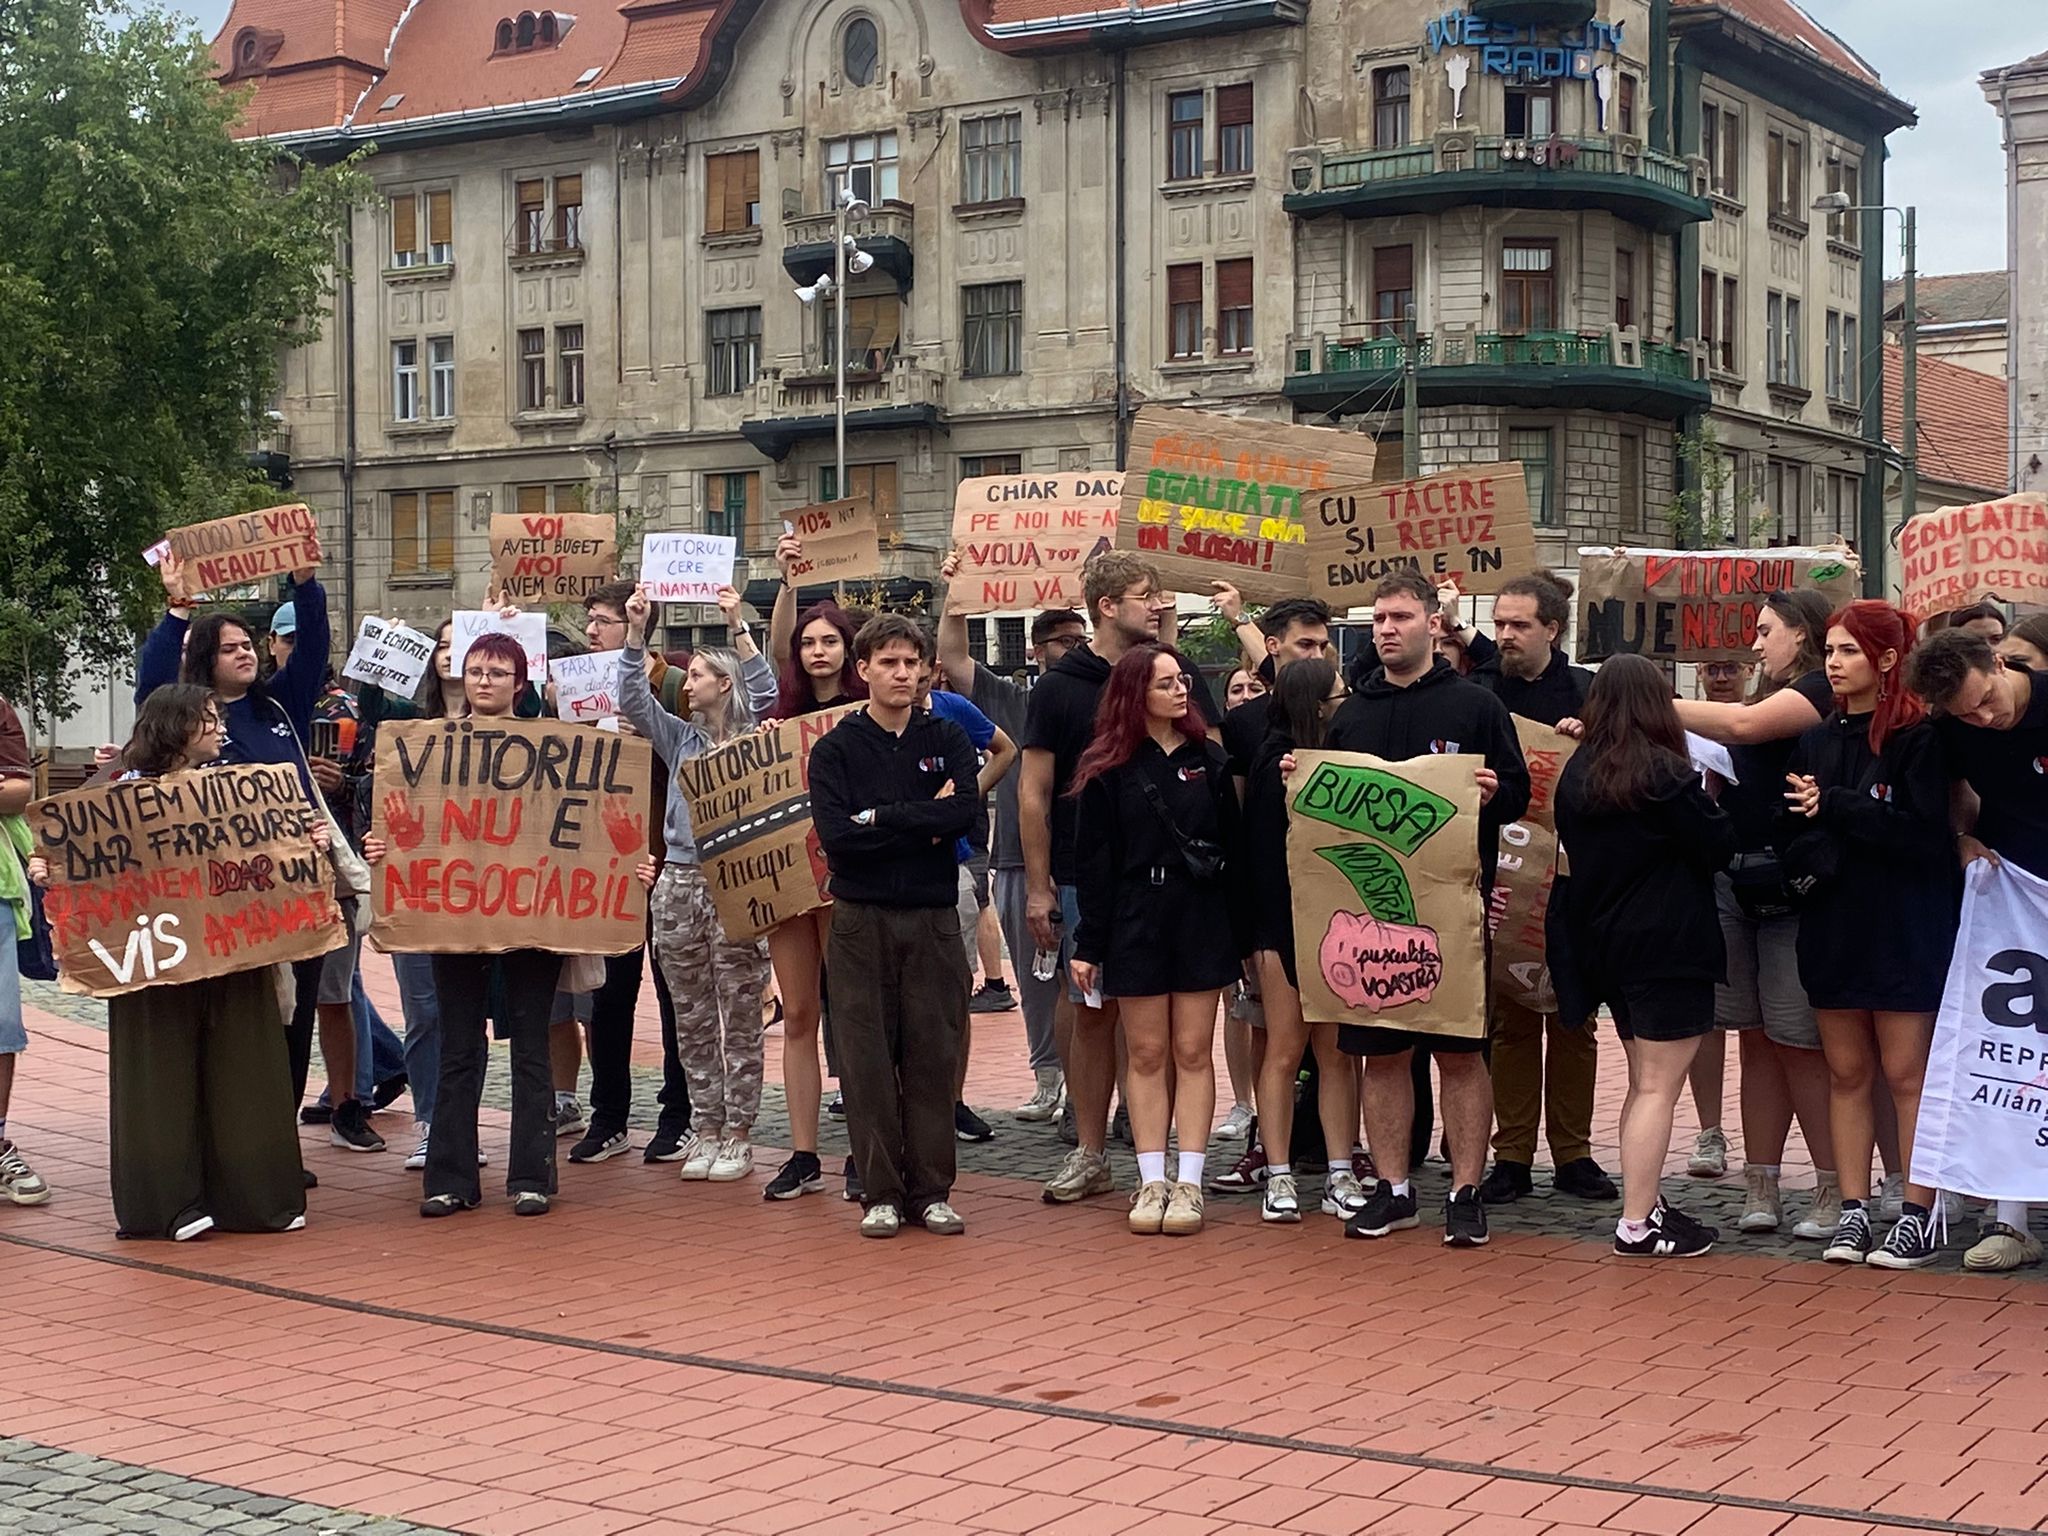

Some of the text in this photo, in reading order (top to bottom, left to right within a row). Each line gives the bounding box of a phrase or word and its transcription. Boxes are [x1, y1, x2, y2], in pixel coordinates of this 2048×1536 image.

[1075, 479, 1124, 497] DAC
[798, 511, 831, 535] 10%
[970, 513, 1000, 532] PE
[1014, 511, 1049, 530] NOI
[1319, 496, 1357, 526] CU
[238, 514, 265, 544] DE
[263, 508, 313, 537] VOCI
[522, 516, 564, 540] VOI
[1137, 525, 1169, 551] UN
[1396, 515, 1496, 551] REFUZ
[553, 539, 605, 557] BUGET
[650, 539, 726, 556] VIITORUL
[1045, 547, 1081, 563] TOT
[513, 556, 567, 577] NOI
[667, 560, 704, 575] CERE
[1433, 552, 1449, 573] E
[500, 575, 547, 597] AVEM
[1643, 555, 1798, 597] VIITORUL
[1983, 569, 2025, 589] CEI
[983, 575, 1064, 604] NU VĂ
[1585, 598, 1764, 654] NU E NEGO
[371, 647, 389, 661] NU
[40, 783, 184, 847] SUNTEM
[1303, 768, 1438, 845] BURSA
[440, 796, 588, 850] NU E
[66, 835, 142, 882] DAR
[228, 807, 313, 848] BURSE
[207, 853, 275, 896] DOAR
[279, 857, 319, 884] UN
[1970, 1084, 2048, 1121] Alian
